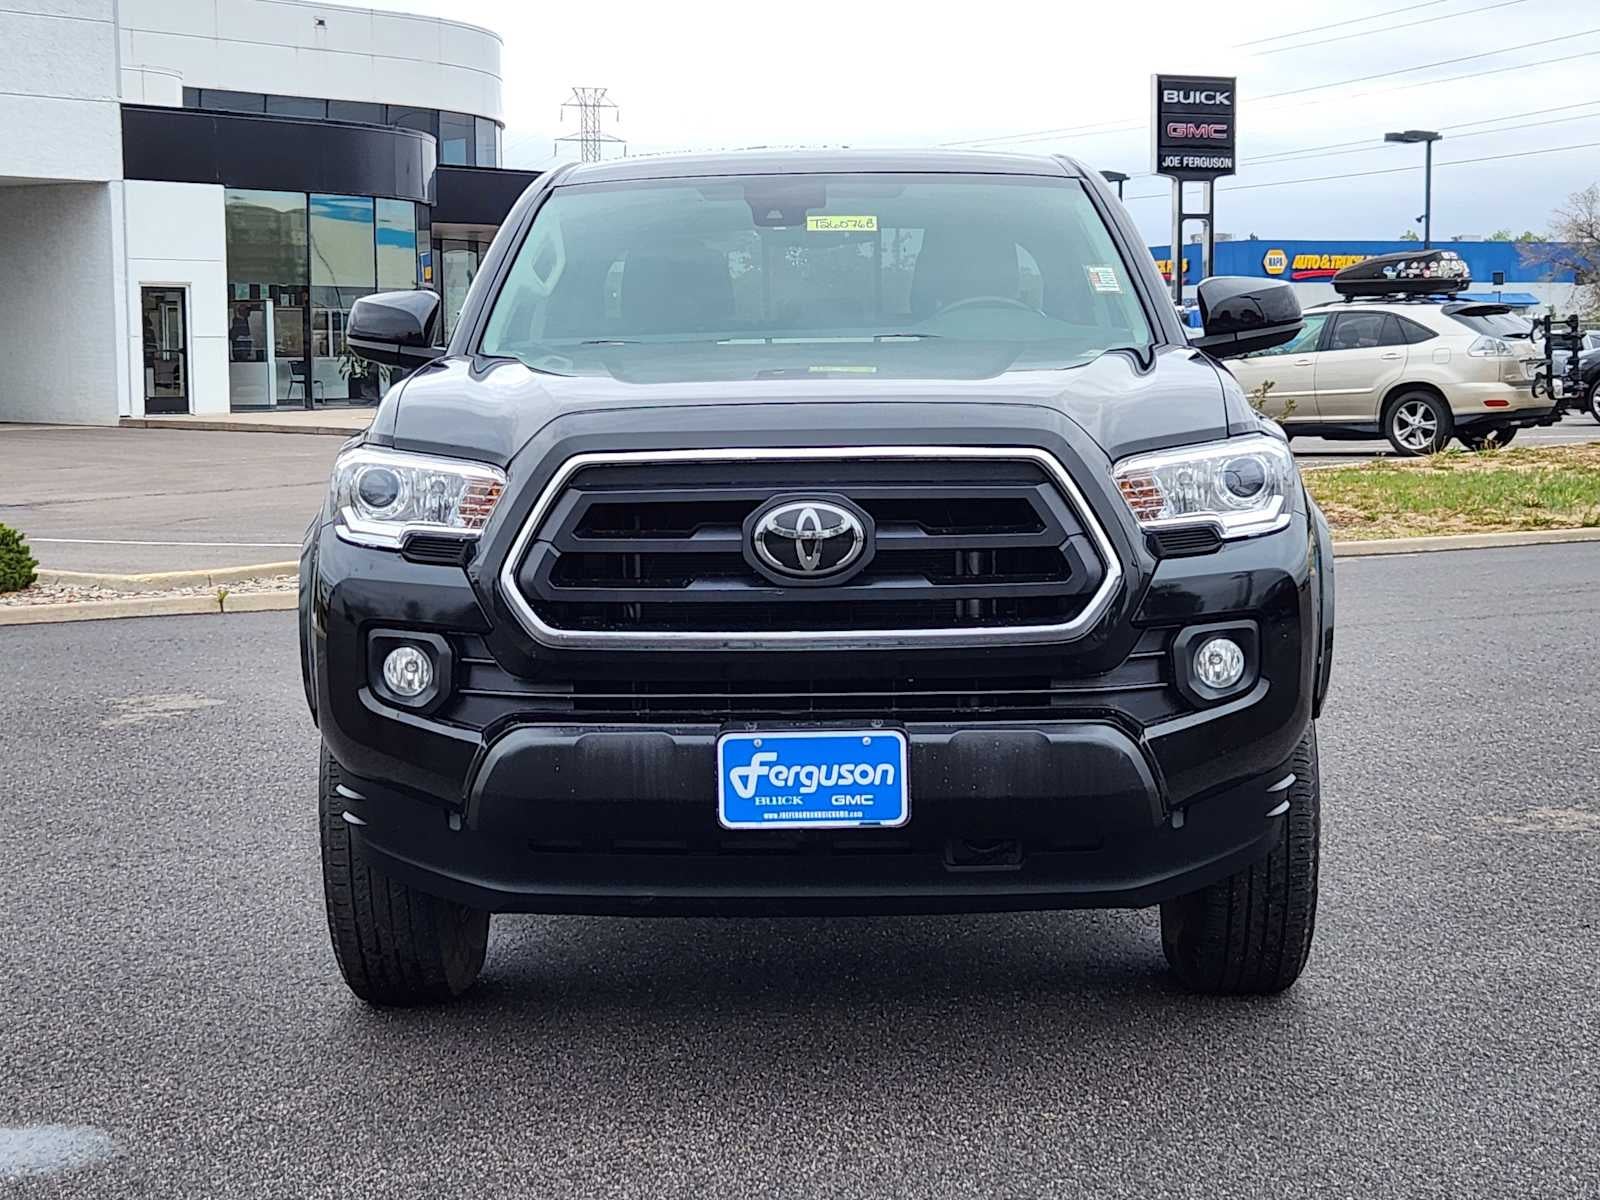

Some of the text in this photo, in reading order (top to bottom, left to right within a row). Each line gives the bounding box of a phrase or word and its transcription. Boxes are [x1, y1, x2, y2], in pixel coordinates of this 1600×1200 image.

[1163, 90, 1231, 105] BUICK
[1167, 123, 1227, 138] GMC
[1162, 156, 1232, 168] JOE FERGUSON
[729, 751, 895, 799] Ferguson
[755, 795, 874, 806] BUICK GMC
